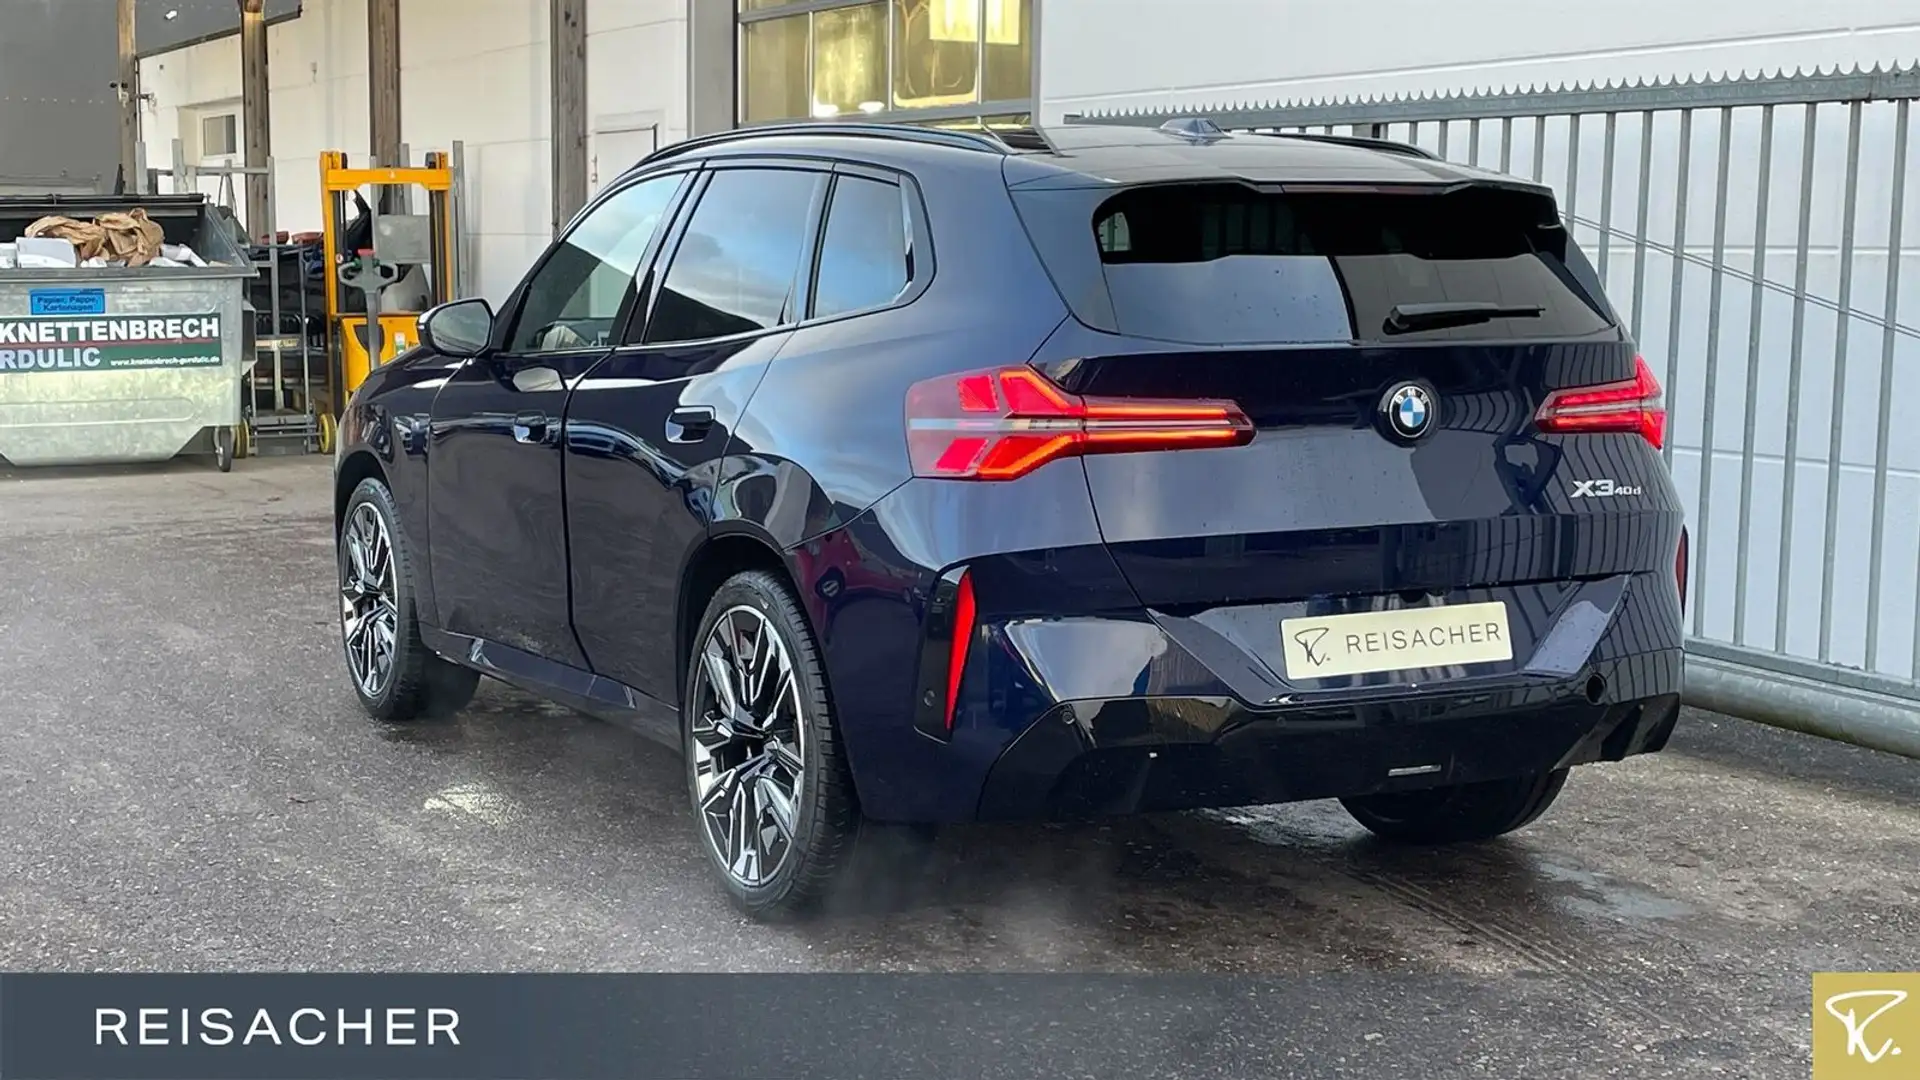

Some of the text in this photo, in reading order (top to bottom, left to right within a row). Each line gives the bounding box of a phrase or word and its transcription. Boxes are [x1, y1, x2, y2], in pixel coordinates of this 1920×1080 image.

[0, 318, 219, 342] KNETTENBRECH
[1394, 388, 1429, 404] BMW
[1346, 622, 1501, 653] REISACHER
